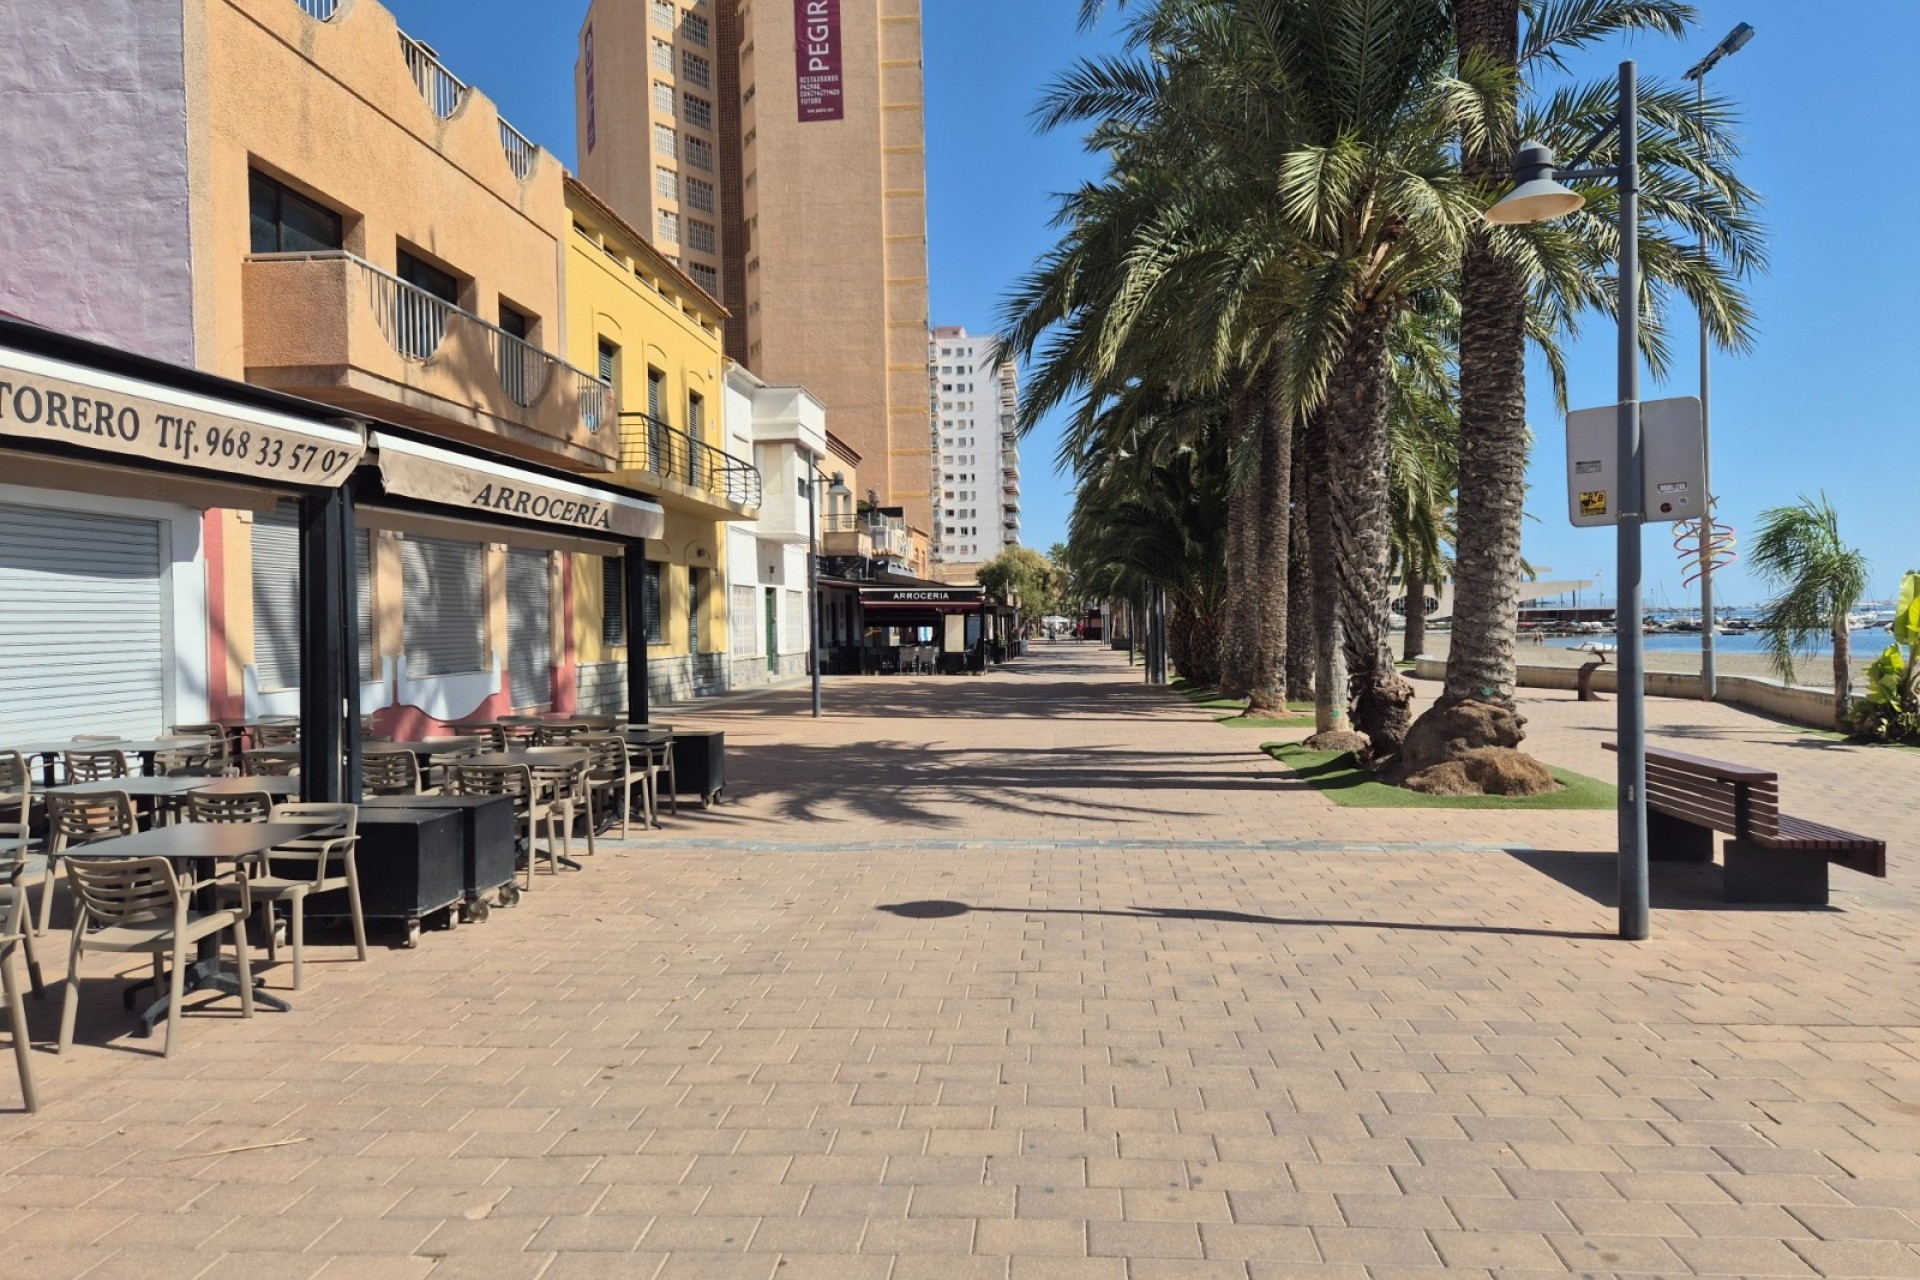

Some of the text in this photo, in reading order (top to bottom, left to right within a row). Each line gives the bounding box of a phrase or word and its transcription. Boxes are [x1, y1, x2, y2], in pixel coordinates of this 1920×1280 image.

[807, 0, 830, 71] PEGIR
[155, 414, 199, 459] Tlf.
[206, 426, 250, 459] 968
[255, 437, 283, 467] 33
[288, 443, 319, 473] 57
[472, 483, 610, 529] ARROCERÍA
[893, 592, 949, 600] ARROCERIA
